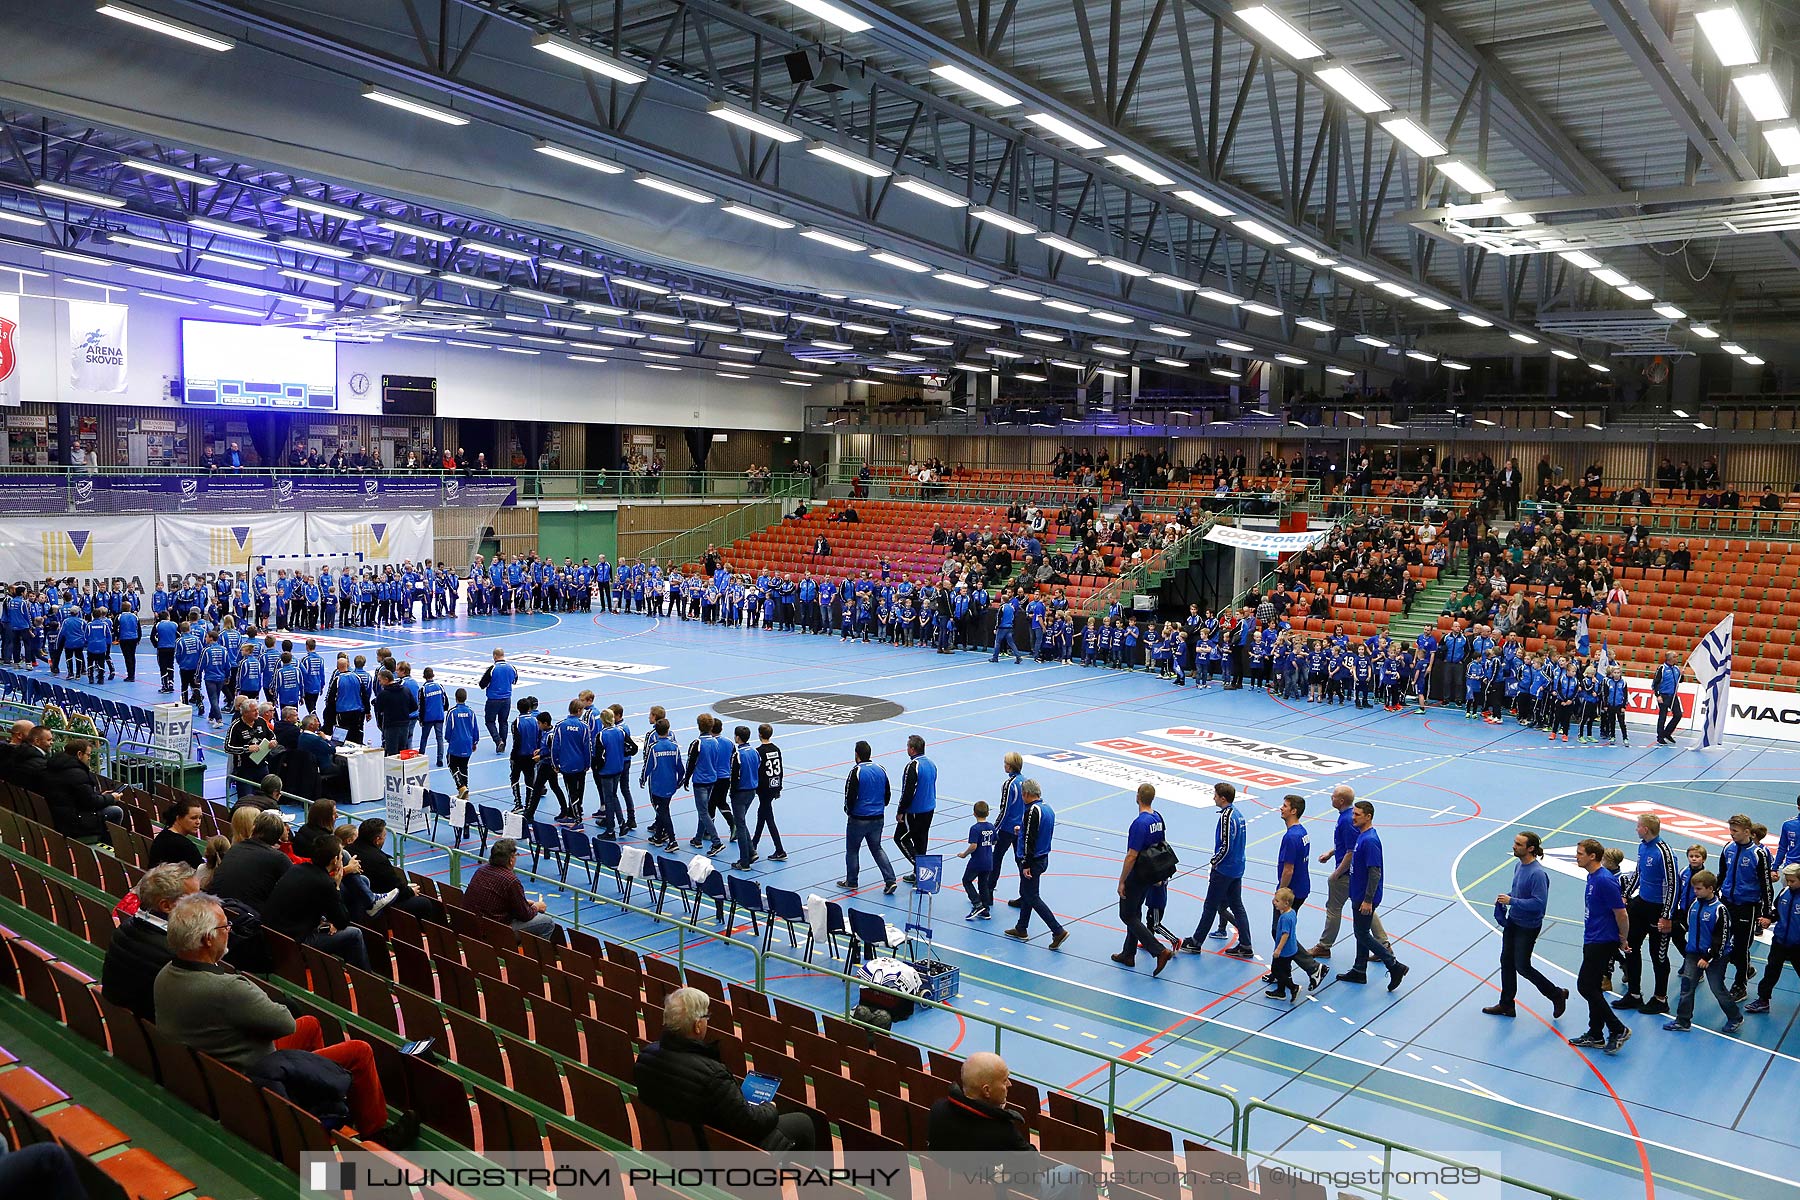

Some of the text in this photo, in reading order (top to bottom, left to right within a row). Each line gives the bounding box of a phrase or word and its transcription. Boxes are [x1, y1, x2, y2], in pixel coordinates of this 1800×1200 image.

[86, 345, 123, 357] ARENA
[85, 354, 124, 366] SKÖVDE
[383, 378, 389, 386] H
[431, 381, 437, 389] G
[1263, 533, 1321, 544] FORUM
[511, 654, 634, 672] Dialect
[1343, 655, 1354, 666] 19
[155, 720, 166, 736] EY
[168, 720, 191, 736] EY
[1205, 736, 1349, 770] PAROC
[765, 758, 781, 777] 33
[386, 775, 402, 793] EY
[386, 793, 403, 804] Building
